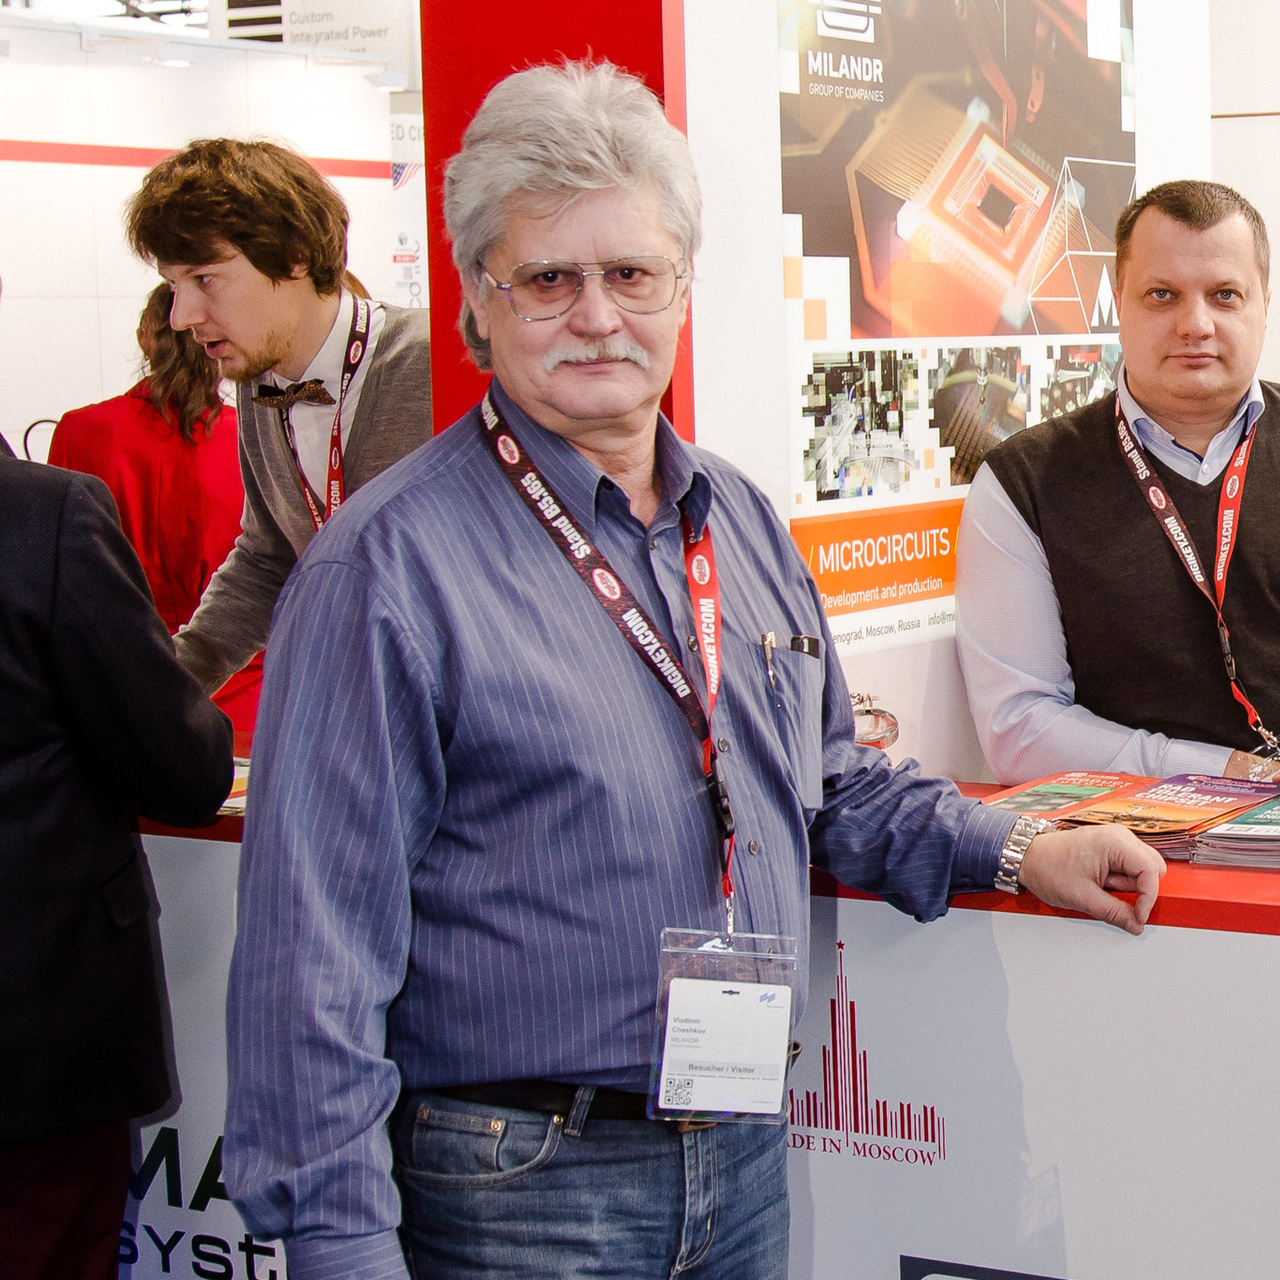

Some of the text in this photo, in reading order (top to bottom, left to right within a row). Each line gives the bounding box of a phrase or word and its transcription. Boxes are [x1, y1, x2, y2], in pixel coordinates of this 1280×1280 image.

[289, 10, 334, 25] Custom
[352, 25, 389, 40] Power
[807, 49, 884, 84] MILANDR
[808, 83, 885, 103] GROUP OF COMPANIES
[1127, 449, 1151, 481] Stand
[520, 471, 592, 560] Stand B5.165
[818, 527, 951, 575] MICROCIRCUITS
[1164, 515, 1205, 583] DIGIKEY.COM
[1216, 509, 1235, 582] DIGIKEY.COM
[820, 577, 943, 609] Development and production
[621, 607, 692, 699] DIGIKEY.COM
[698, 597, 716, 696] DIGIKEY.COM
[832, 630, 865, 646] enograd,
[688, 1063, 725, 1072] Besucher
[730, 1066, 755, 1074] Visitor
[785, 1132, 937, 1167] DE IN MOSCOW
